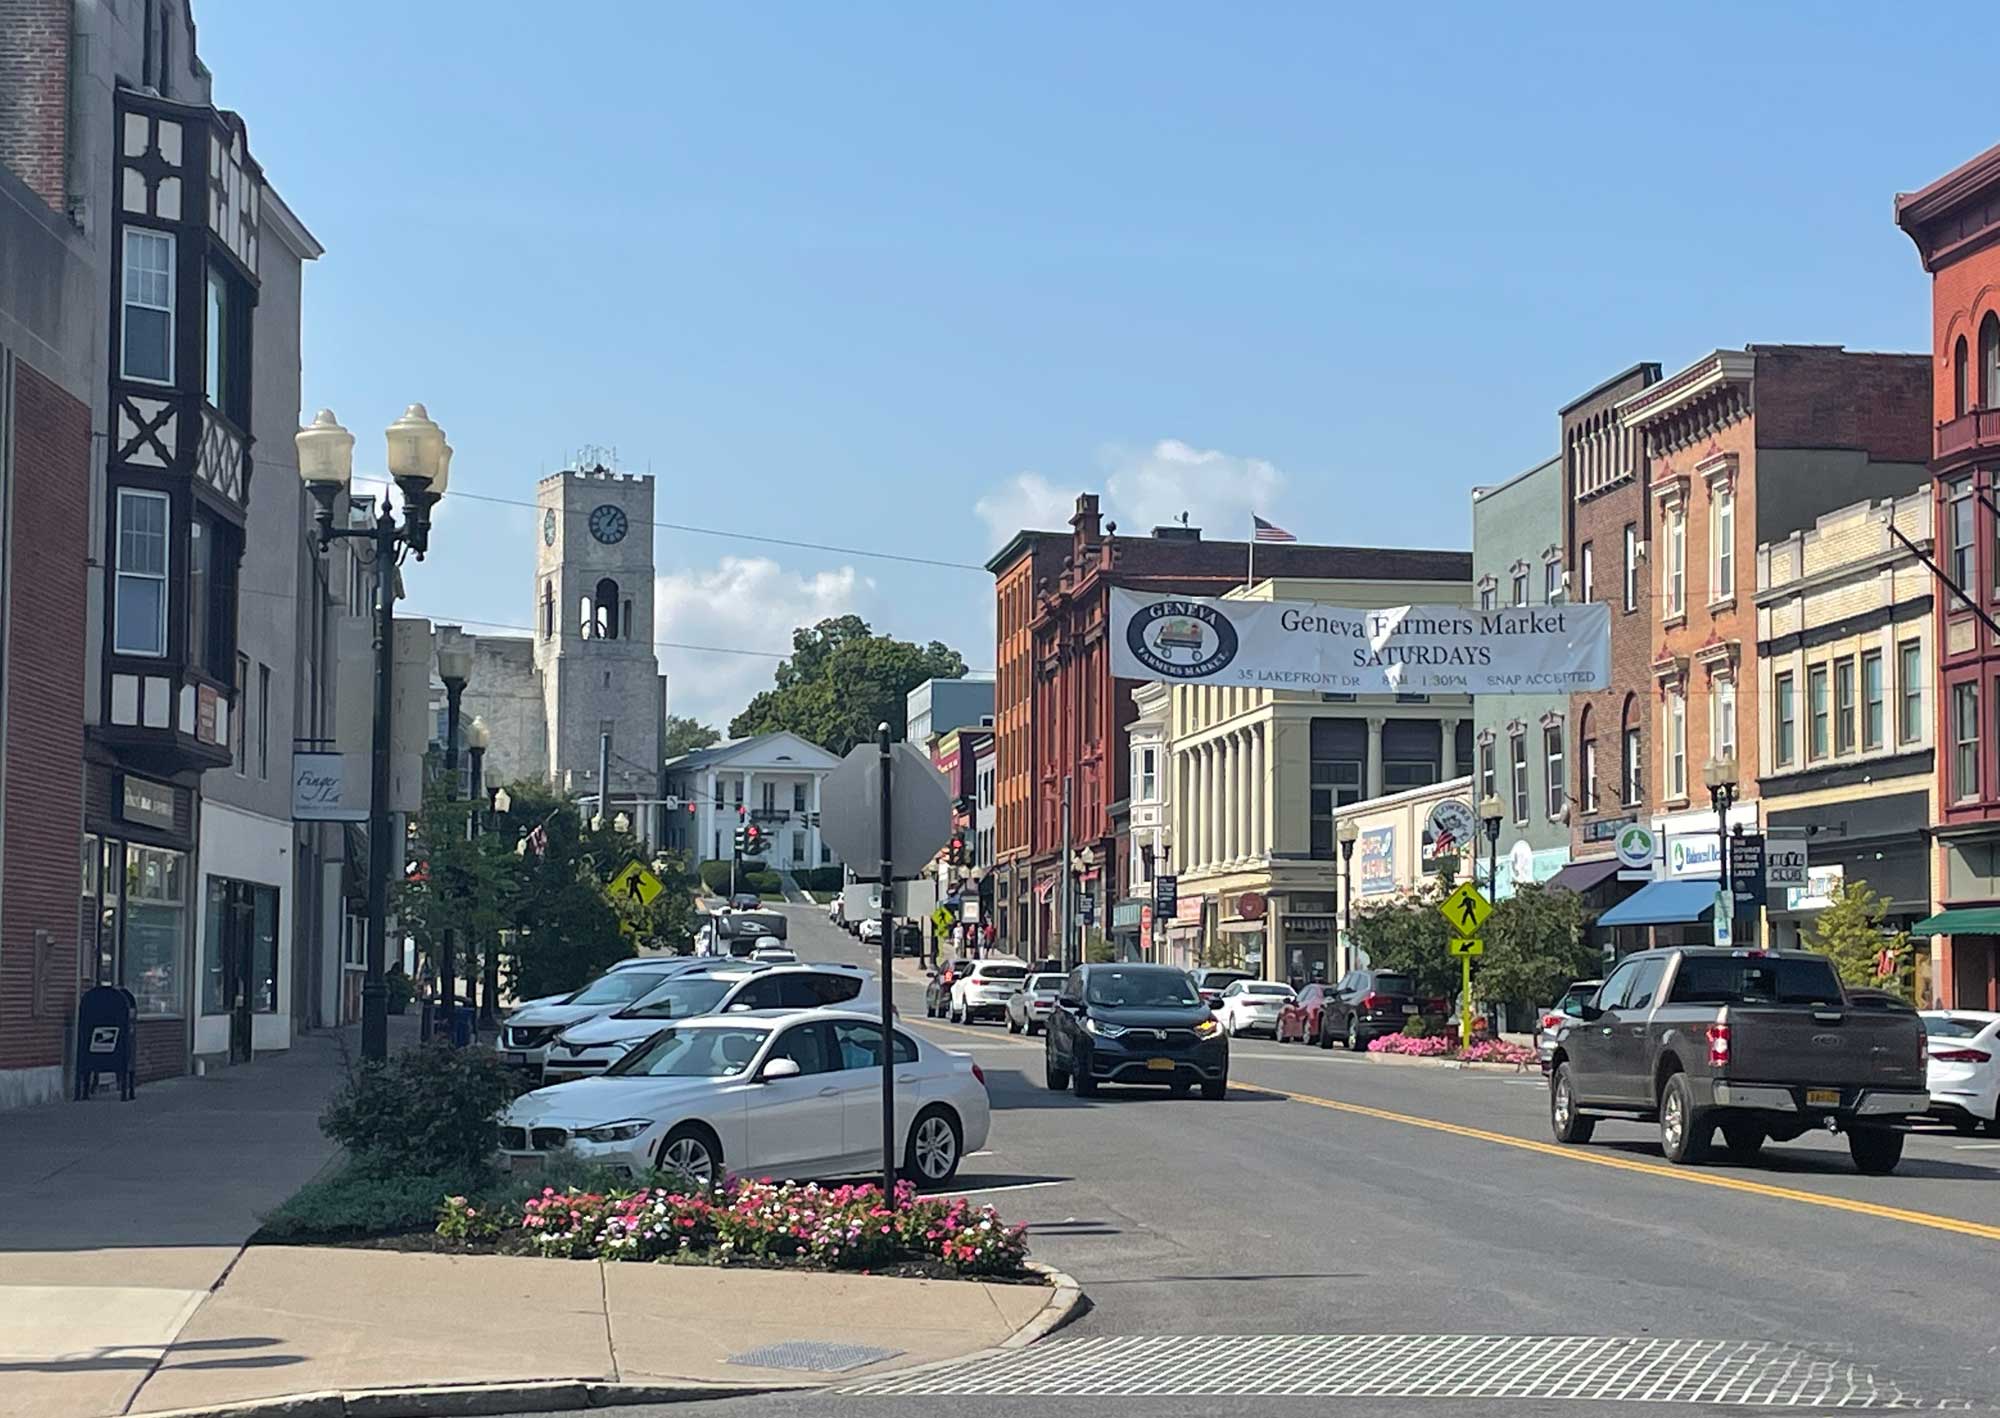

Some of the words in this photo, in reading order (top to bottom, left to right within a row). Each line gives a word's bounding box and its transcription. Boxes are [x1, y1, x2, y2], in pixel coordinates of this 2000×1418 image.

[1149, 602, 1218, 625] GENEVA
[1281, 609, 1366, 638] Geneva
[1373, 616, 1473, 638] Farmers
[1480, 611, 1566, 635] Market
[1138, 647, 1182, 674] FARMERS
[1184, 653, 1227, 675] MARKET
[1353, 646, 1492, 667] SATURDAYS
[1238, 669, 1254, 680] 35
[1258, 670, 1338, 685] LAKEFRONT
[1342, 675, 1361, 686] DR
[1487, 674, 1522, 686] SNAP
[1525, 671, 1596, 685] ACCEPTED
[297, 769, 341, 800] Finger
